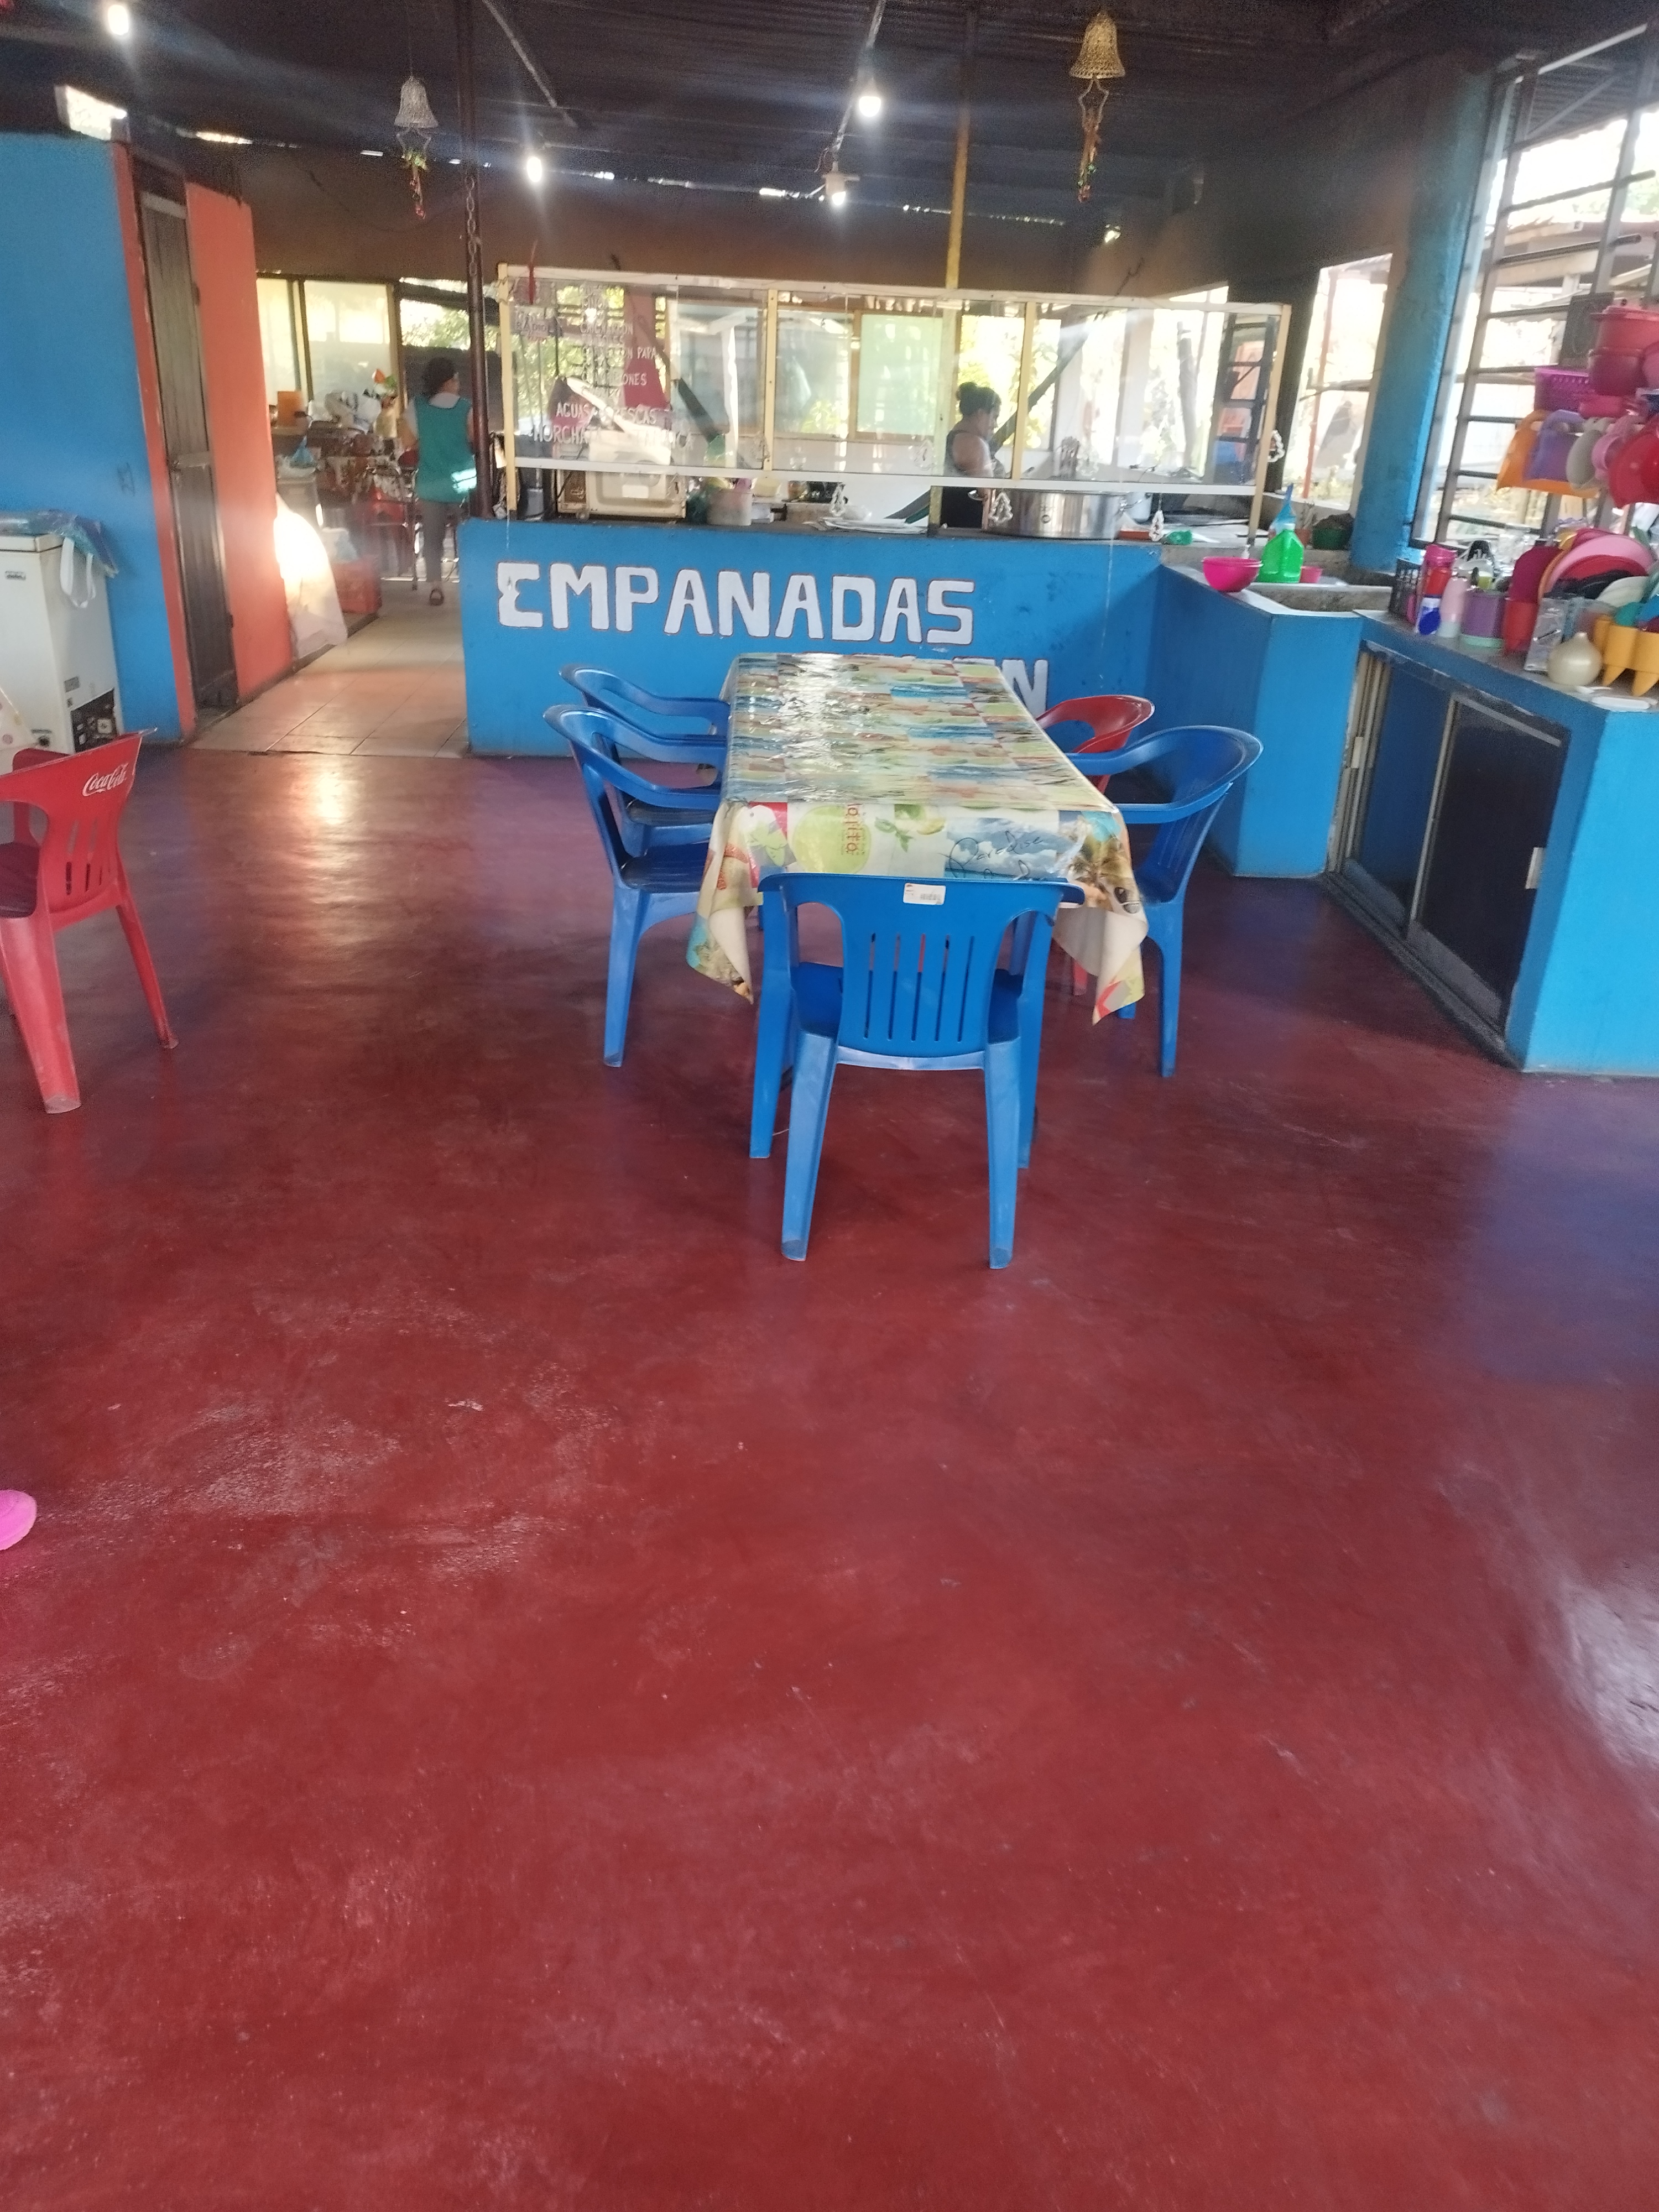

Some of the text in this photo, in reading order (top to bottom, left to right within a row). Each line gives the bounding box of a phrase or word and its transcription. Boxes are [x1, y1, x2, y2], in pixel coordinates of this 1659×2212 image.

[637, 347, 657, 359] PAPA
[556, 402, 657, 425] AGUAS RESCAS
[497, 561, 976, 646] EMPANADAS
[938, 830, 1044, 878] Paradise
